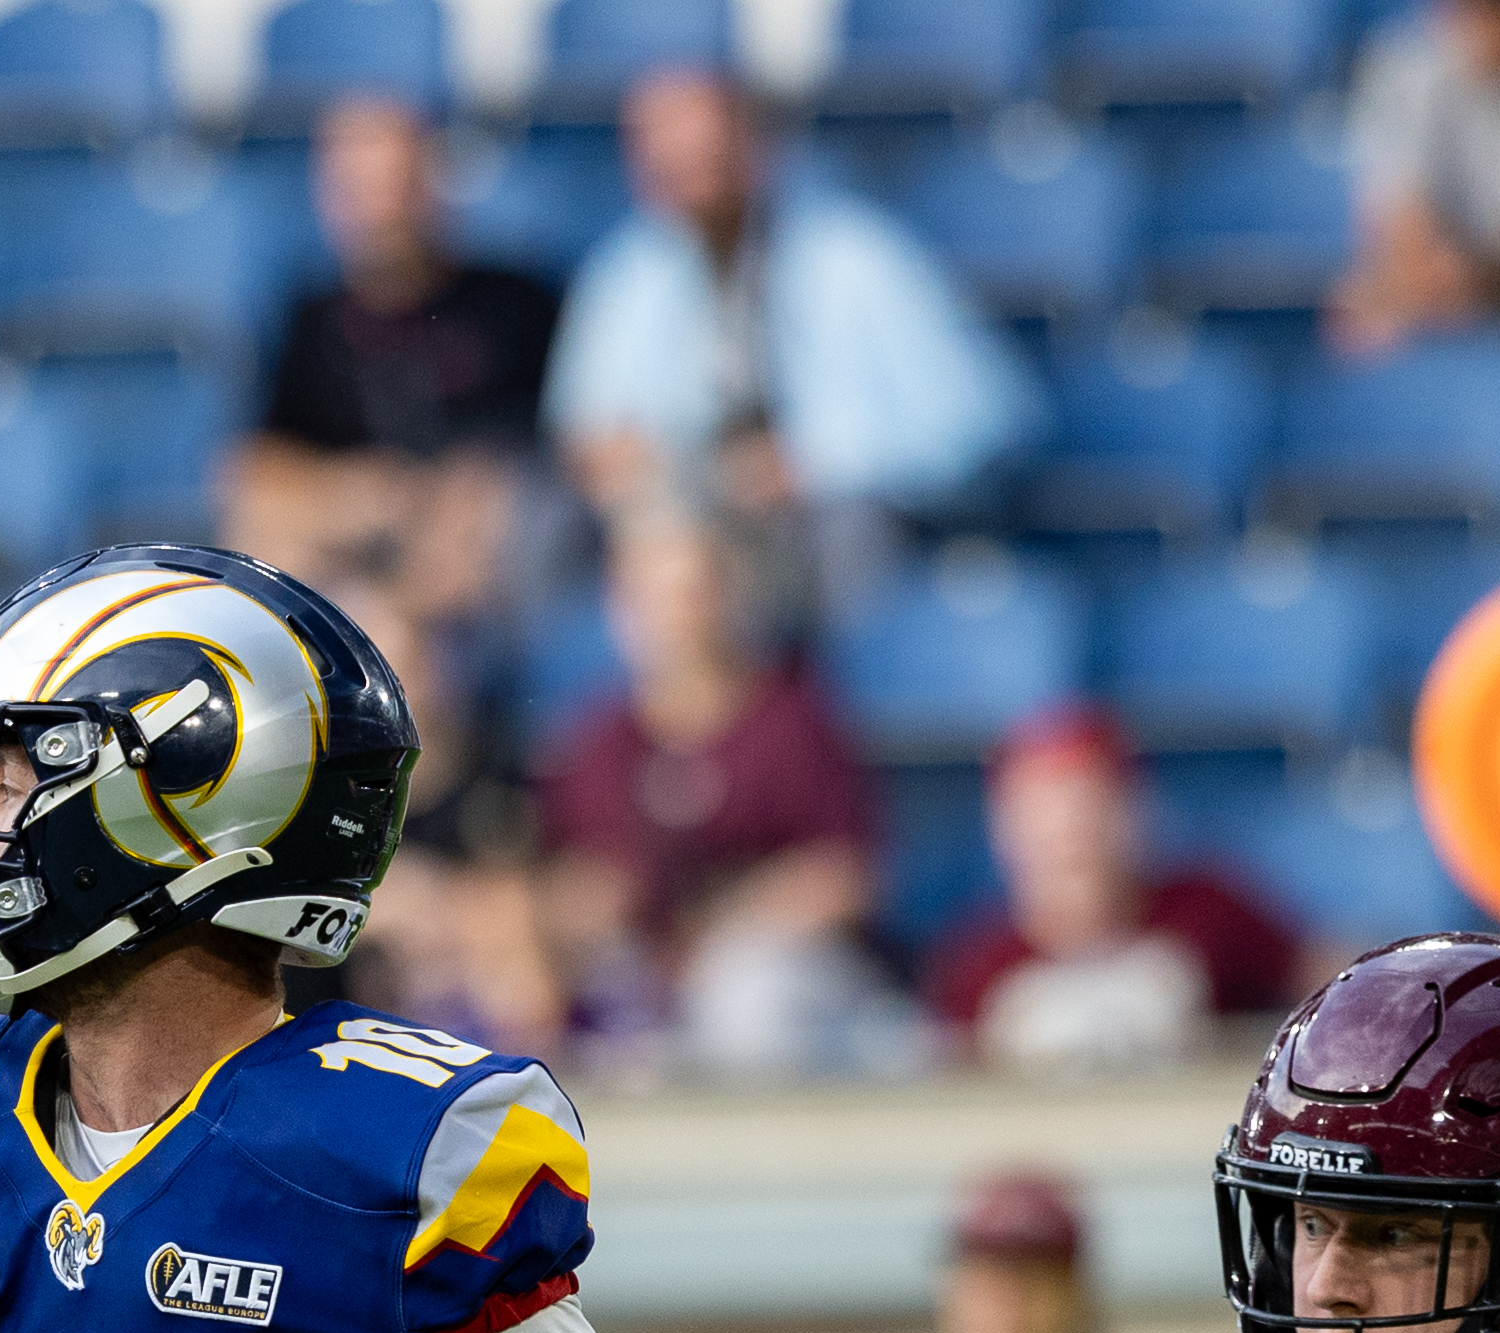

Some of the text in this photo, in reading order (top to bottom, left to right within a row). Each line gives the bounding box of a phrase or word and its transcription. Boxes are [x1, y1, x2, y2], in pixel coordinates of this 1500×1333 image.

[308, 1018, 493, 1088] 10
[1269, 1143, 1364, 1175] FORELLE
[164, 1258, 276, 1310] AFLE
[163, 1297, 266, 1319] THE LEAGUE EUROPE
